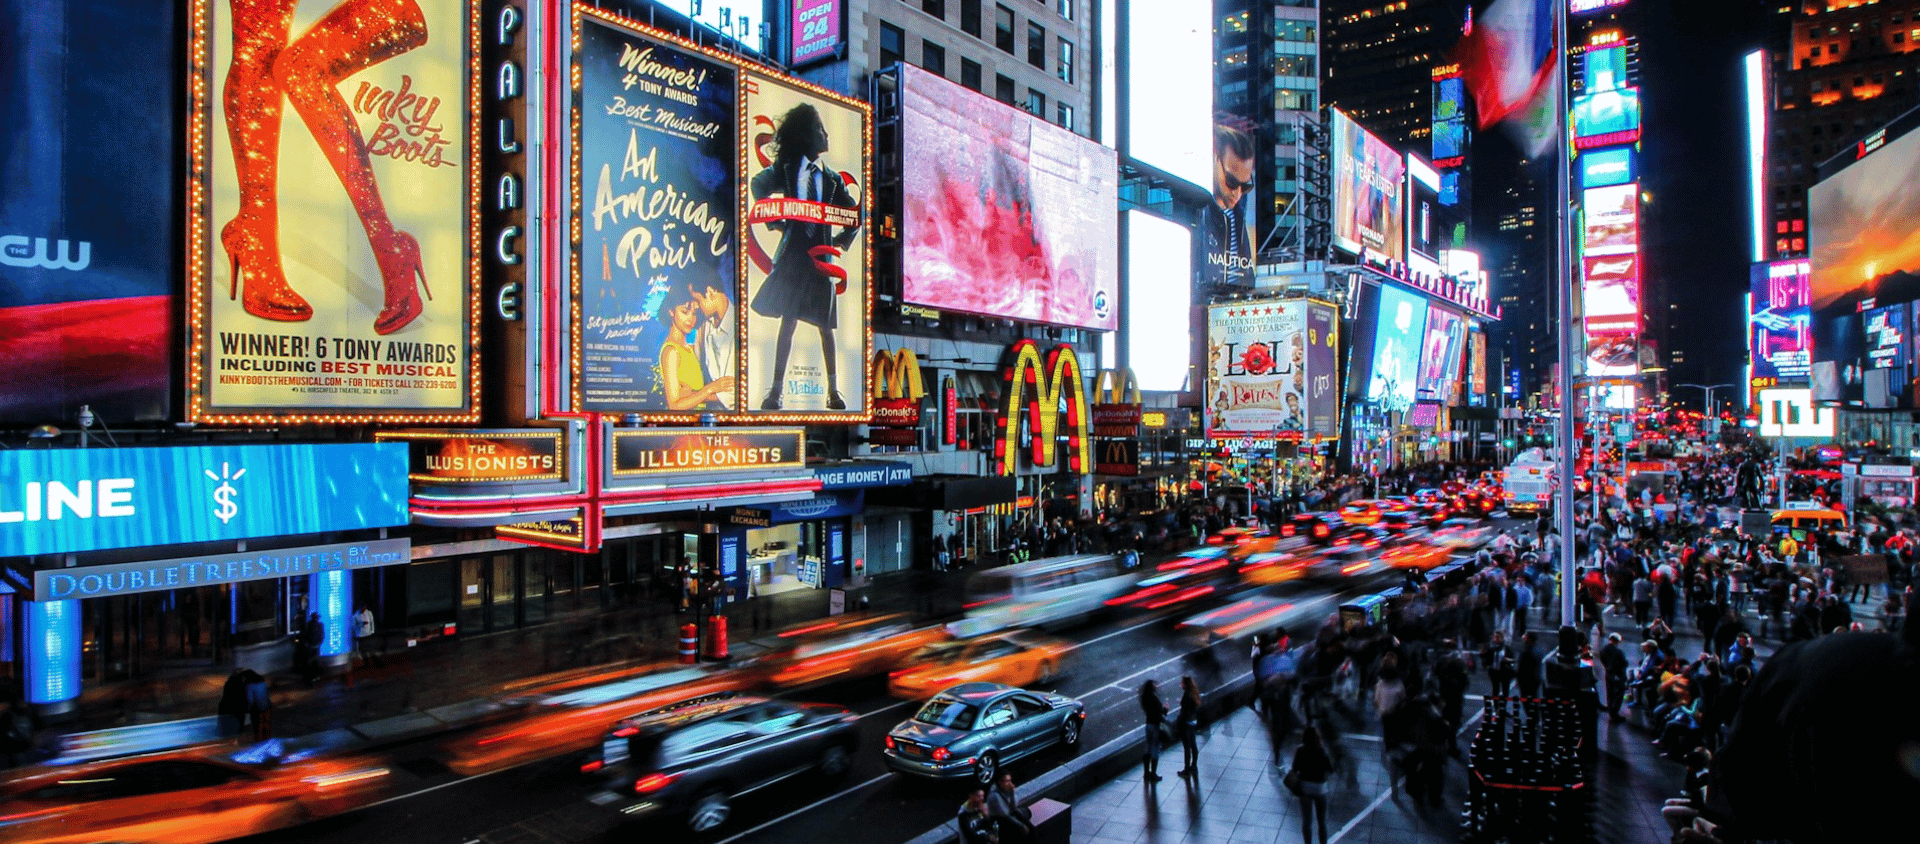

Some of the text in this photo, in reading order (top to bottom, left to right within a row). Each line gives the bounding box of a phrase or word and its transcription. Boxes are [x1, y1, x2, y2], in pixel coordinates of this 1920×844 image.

[799, 2, 832, 22] OPEN
[803, 16, 828, 41] 24
[796, 35, 836, 57] HOURS
[619, 42, 707, 91] Winner!
[622, 73, 698, 106] 4 TONY AWARDS
[606, 96, 651, 121] Best
[655, 108, 719, 139] Musical!
[366, 122, 457, 167] Boots
[499, 7, 520, 319] PALACE
[620, 128, 658, 183] An
[592, 184, 728, 256] American
[754, 201, 822, 219] FINAL MONTHS
[0, 235, 91, 271] CW
[9, 247, 28, 255] THE
[615, 226, 696, 278] Paris
[1208, 252, 1254, 269] NAUTICA
[220, 332, 456, 364] WINNER! 6 TONY AWARDS
[220, 358, 456, 377] INCLUDING BEST MUSICAL
[220, 374, 342, 386] KINKYBOOTSTHEMUSICAL.COM
[348, 378, 363, 387] FOR
[365, 379, 393, 388] TICKETS
[395, 380, 411, 388] CALL
[469, 445, 496, 454] THE
[707, 436, 729, 446] THE
[426, 455, 553, 470] ILLUSIONISTS
[640, 447, 781, 468] ILLUSIONISTS
[846, 470, 885, 484] MONEY
[890, 469, 911, 481] ATM
[730, 515, 769, 526] EXCHANGE
[735, 507, 761, 517] MONEY
[349, 546, 368, 556] BY
[349, 552, 401, 565] HILTON
